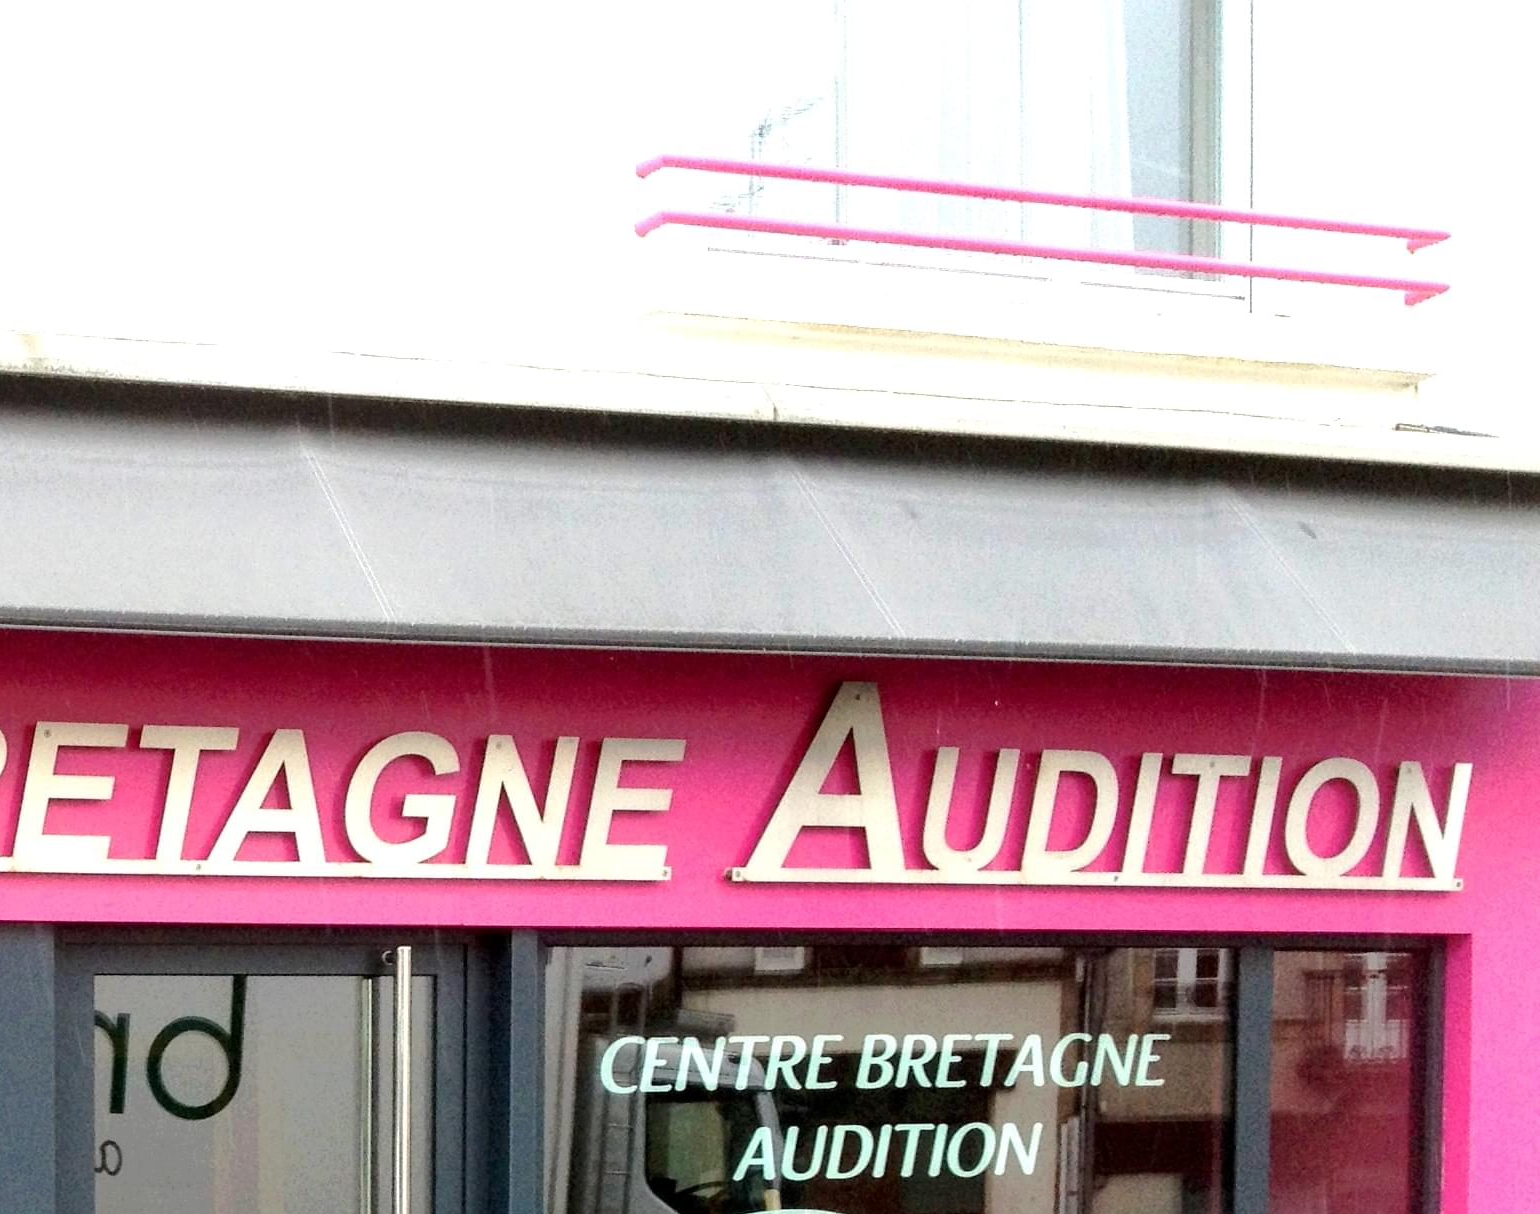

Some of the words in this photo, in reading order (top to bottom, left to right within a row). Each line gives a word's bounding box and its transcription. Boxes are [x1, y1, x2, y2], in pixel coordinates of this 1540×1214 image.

[728, 681, 1472, 891] AUDITION
[600, 1033, 838, 1094] CENTRE
[855, 1033, 1171, 1090] BRETAGNE
[733, 1121, 1043, 1182] AUDITION
